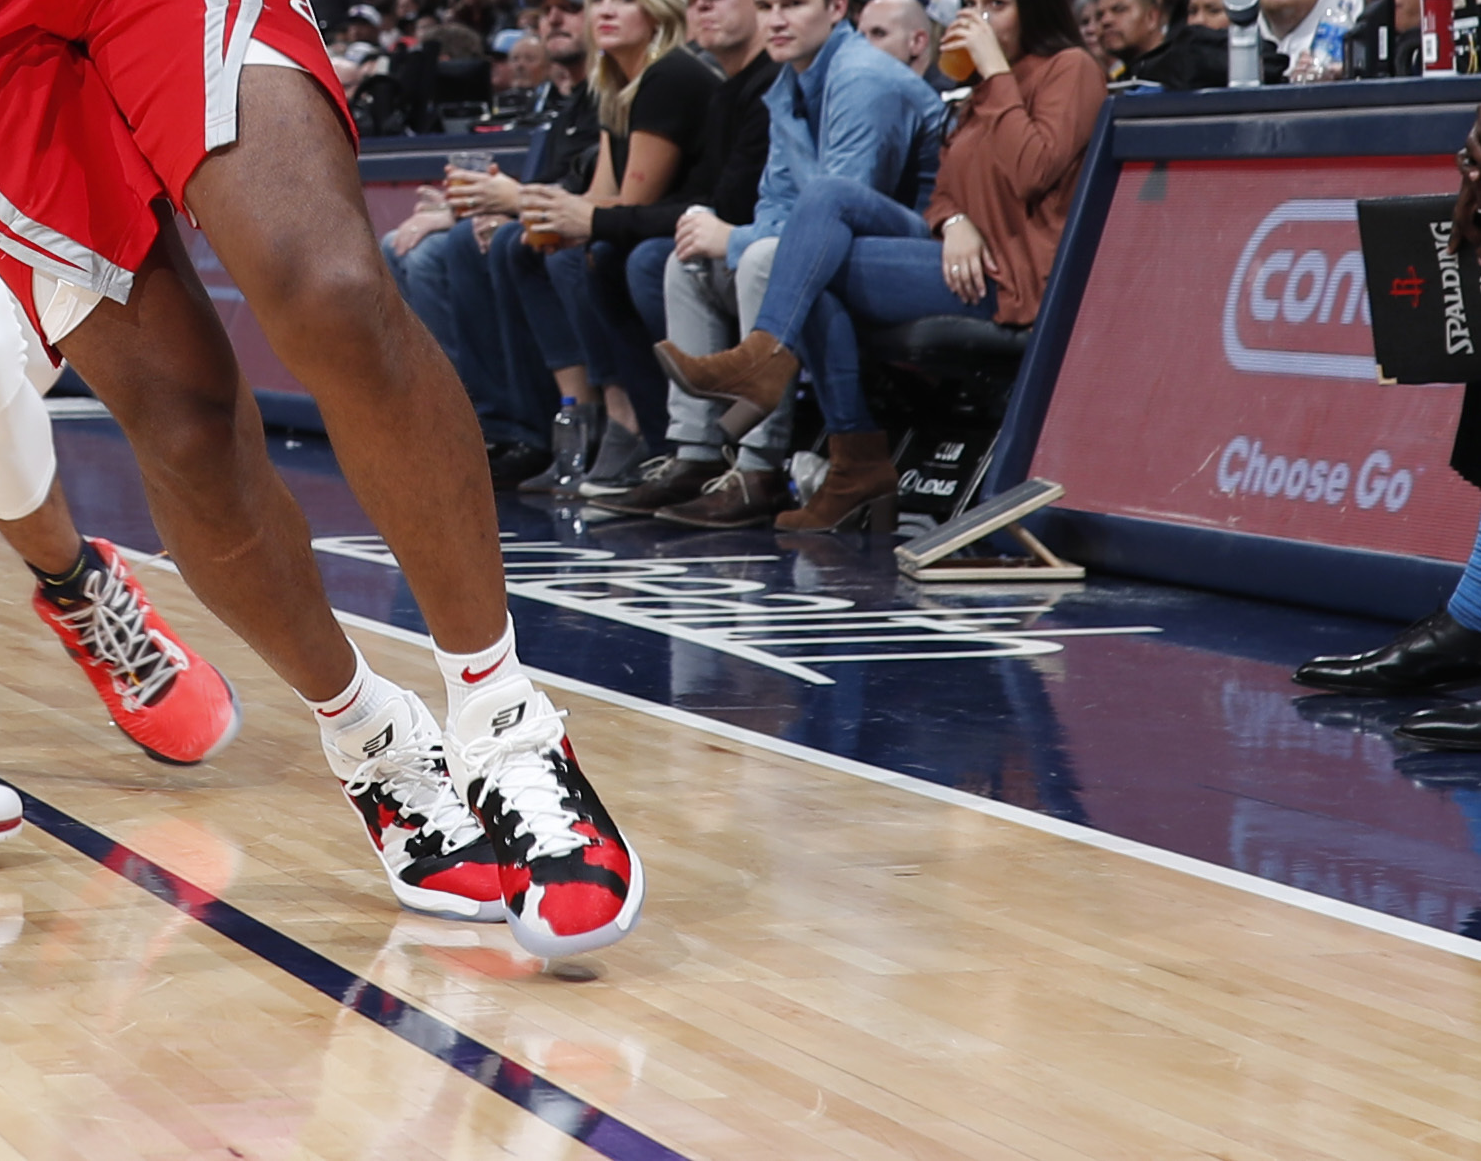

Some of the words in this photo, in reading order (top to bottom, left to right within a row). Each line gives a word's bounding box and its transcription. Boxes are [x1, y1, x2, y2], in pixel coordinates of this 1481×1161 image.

[1430, 221, 1474, 354] SPALDING
[1217, 435, 1351, 505] Choose
[1354, 449, 1414, 513] Go
